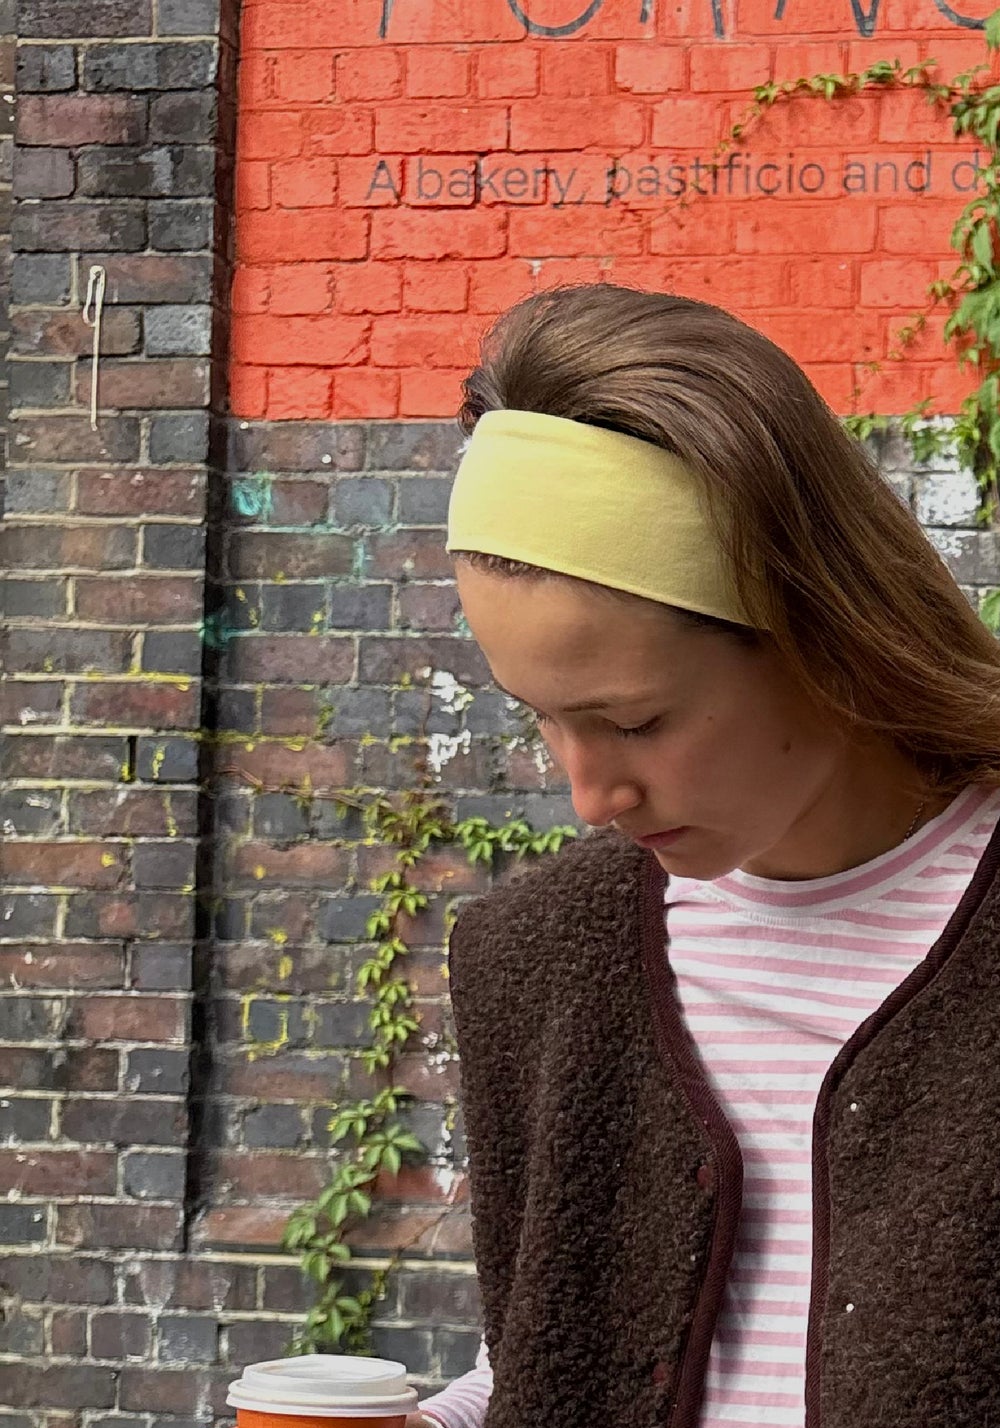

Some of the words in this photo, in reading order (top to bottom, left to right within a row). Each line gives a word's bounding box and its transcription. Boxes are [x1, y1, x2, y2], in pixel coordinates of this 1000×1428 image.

[365, 160, 401, 201] A
[416, 157, 588, 209] bakery,
[604, 152, 825, 208] pastificio
[841, 149, 932, 193] and
